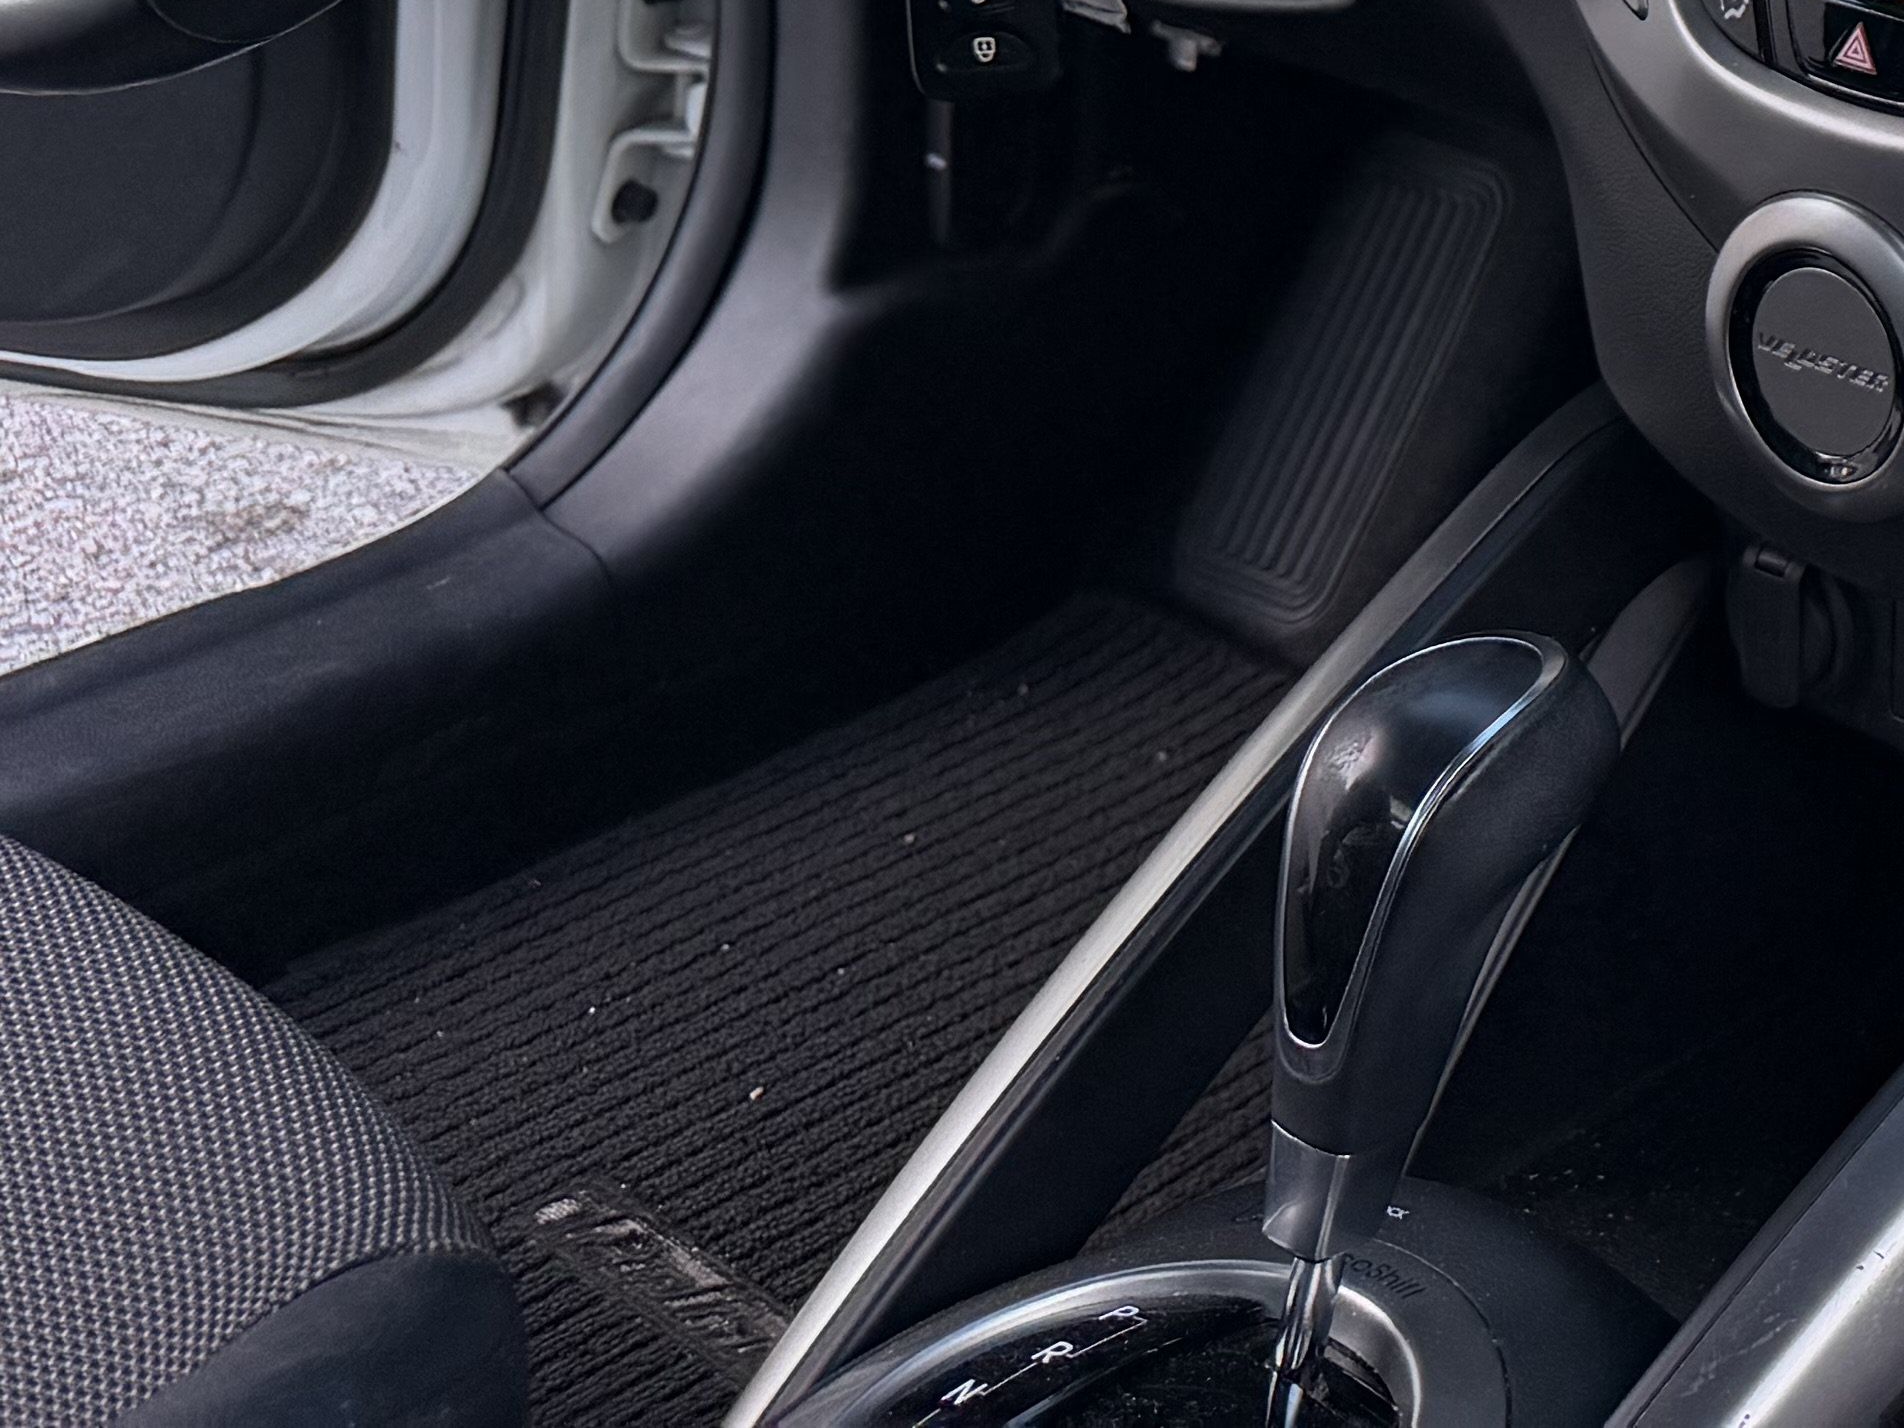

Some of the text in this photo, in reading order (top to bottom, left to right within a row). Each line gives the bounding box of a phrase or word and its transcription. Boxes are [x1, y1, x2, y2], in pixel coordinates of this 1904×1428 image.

[1099, 1305, 1140, 1321] P
[1031, 1341, 1074, 1364] R
[941, 1378, 989, 1406] N
